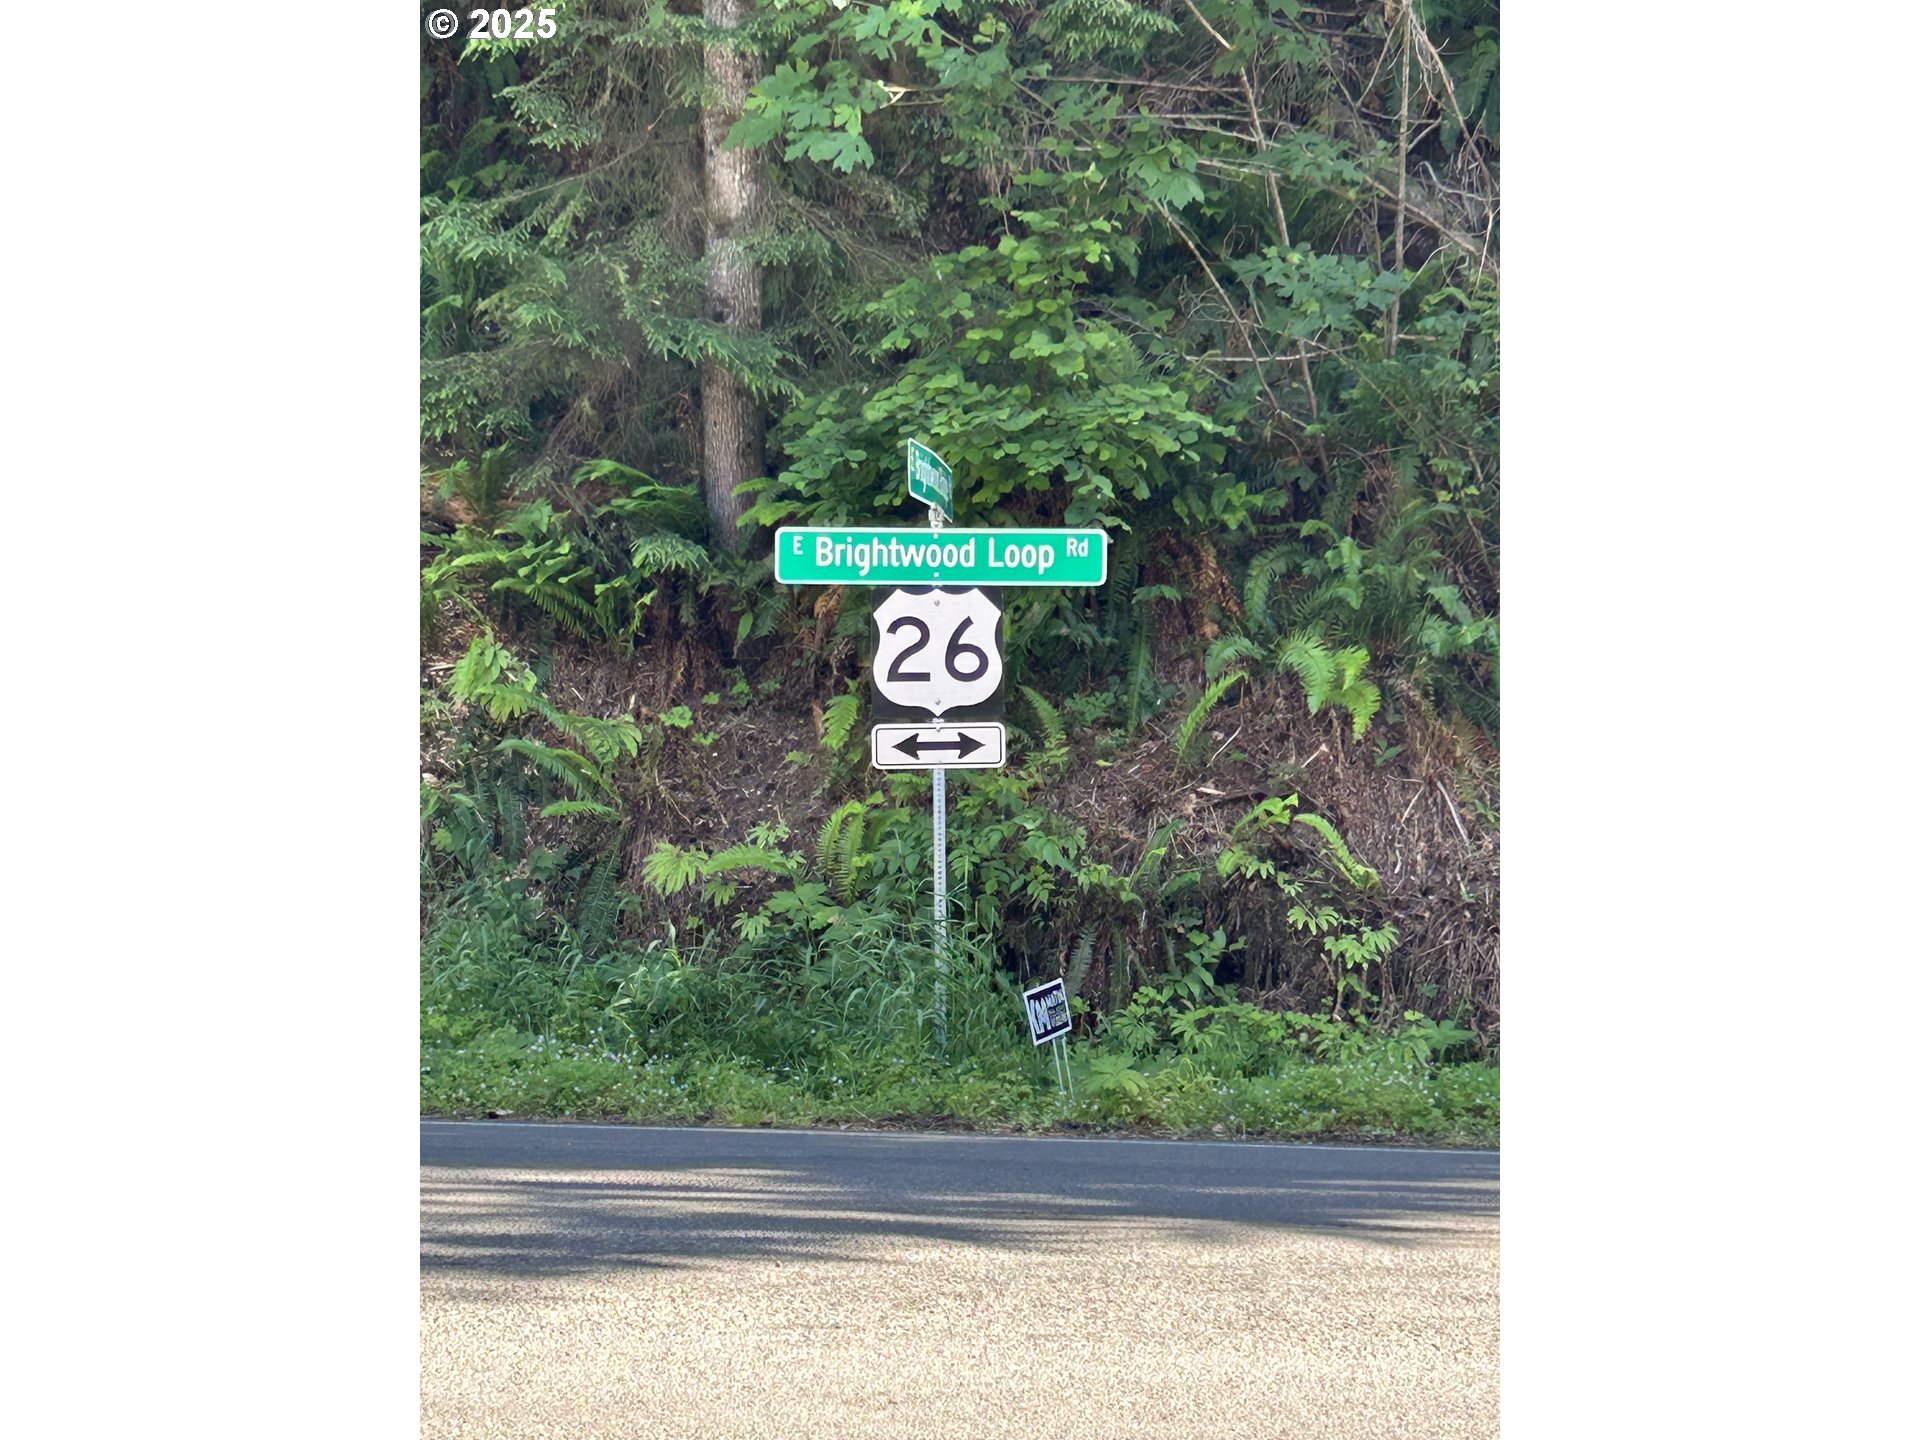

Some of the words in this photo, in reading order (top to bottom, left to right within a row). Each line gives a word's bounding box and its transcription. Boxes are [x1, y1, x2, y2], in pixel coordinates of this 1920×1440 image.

[792, 536, 804, 555] E
[815, 536, 976, 577] Brightwood
[988, 537, 1055, 575] Loop
[1066, 538, 1089, 557] Rd
[886, 615, 989, 682] 26
